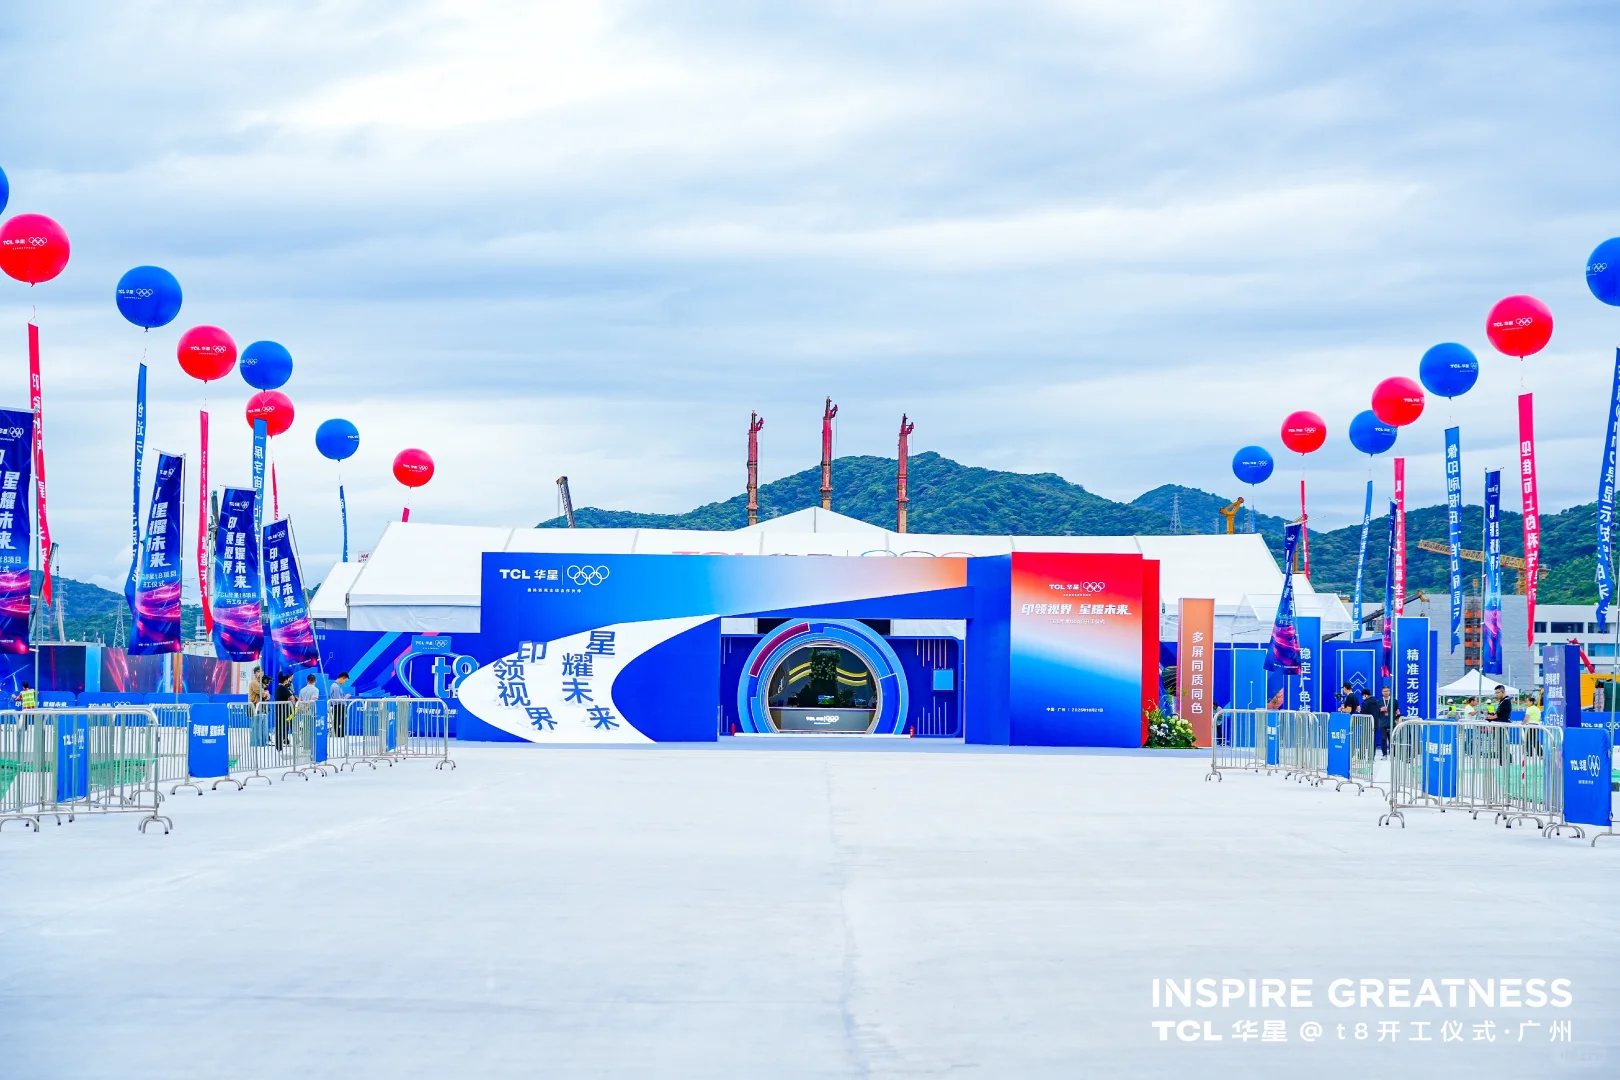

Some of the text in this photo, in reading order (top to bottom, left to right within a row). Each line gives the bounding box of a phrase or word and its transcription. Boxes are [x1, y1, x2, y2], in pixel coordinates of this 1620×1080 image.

[222, 516, 238, 574] 印领视界
[234, 532, 252, 589] 星耀未来
[269, 547, 280, 598] 印领视界
[280, 557, 299, 608] 星耀未来
[499, 568, 558, 580] TCL 华星
[1021, 603, 1132, 616] 印领视界 星耀未来
[492, 640, 558, 730] 印领视界
[562, 630, 620, 730] 星耀未来
[1191, 631, 1204, 714] 多屏同质同色
[1407, 648, 1419, 718] 精准无彩边
[1570, 760, 1579, 770] TCL
